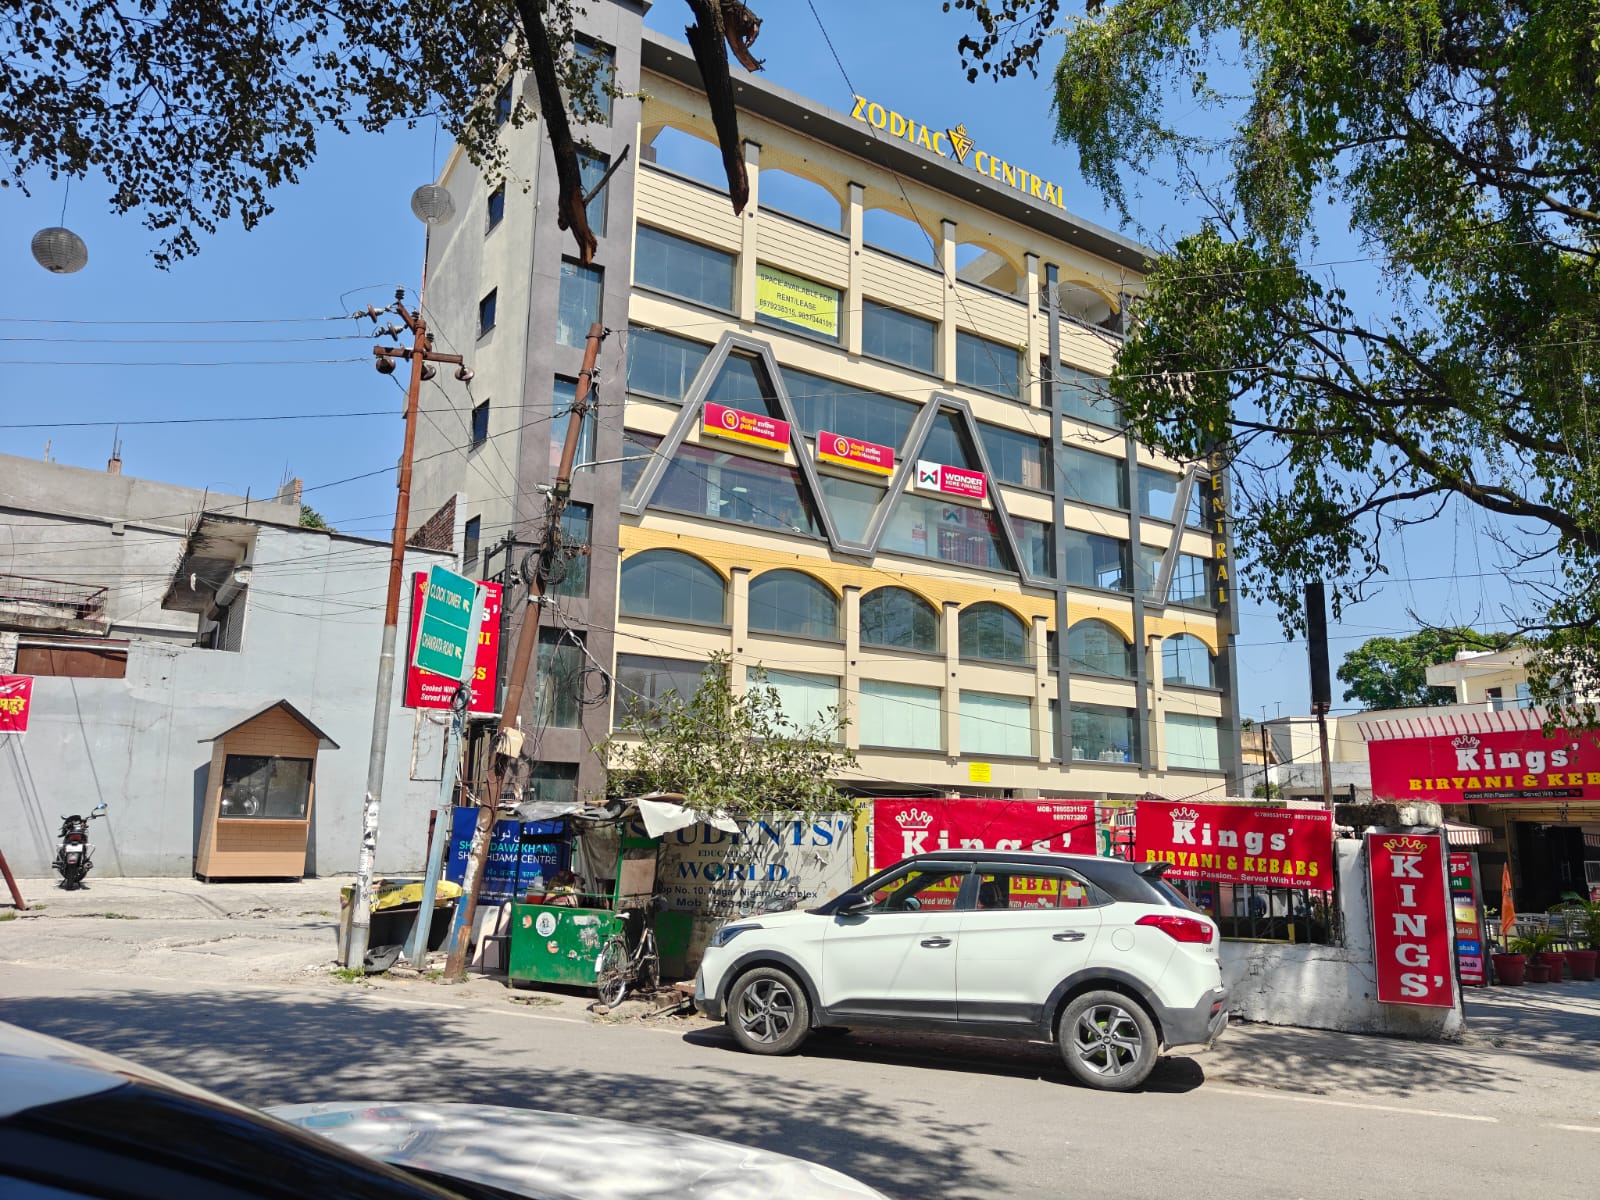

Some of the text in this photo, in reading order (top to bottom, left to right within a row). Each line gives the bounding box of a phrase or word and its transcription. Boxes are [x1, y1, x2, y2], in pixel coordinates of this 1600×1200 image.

[851, 93, 1066, 210] ZODIAC CENTRAL
[760, 273, 833, 303] SPACE AVAILABLE FOR
[944, 472, 983, 486] WONDER
[1211, 452, 1229, 604] CENTRAL
[430, 583, 462, 609] CLOCK TOWER
[442, 638, 455, 657] ROAD
[1456, 742, 1579, 774] Kings'
[1409, 775, 1514, 791] BIRYANI
[1522, 774, 1539, 787] &
[1172, 821, 1294, 856] Kings'
[520, 854, 557, 865] CENTRE
[1146, 849, 1319, 877] BIRYANI & KEBABS
[679, 861, 788, 882] WORLD
[1240, 874, 1270, 883] Served
[1270, 876, 1289, 884] With
[1290, 876, 1312, 886] Love
[674, 886, 691, 894] No.
[709, 887, 737, 899] Nagar
[676, 898, 702, 907] Mob
[1389, 855, 1444, 998] KINGS'
